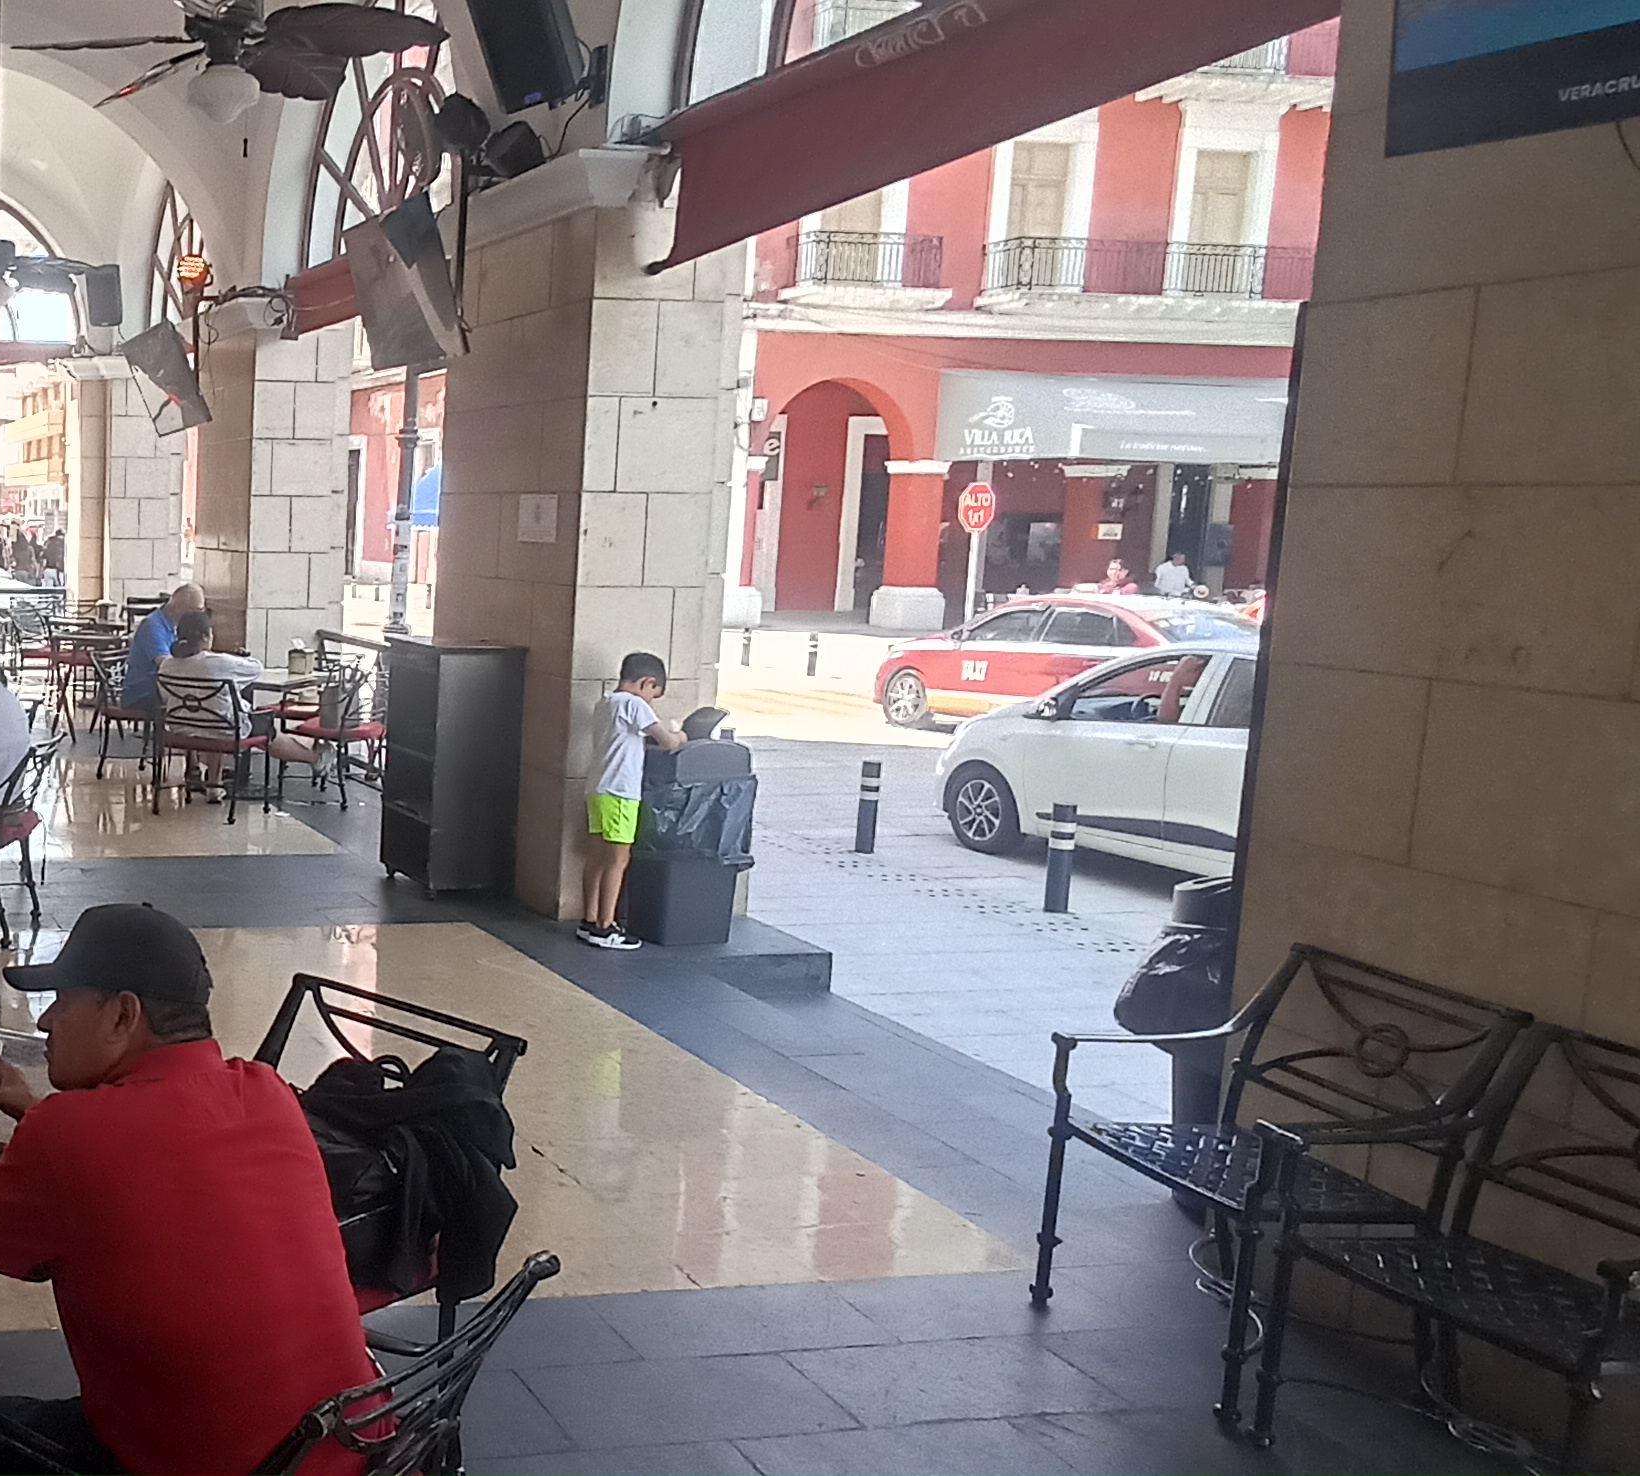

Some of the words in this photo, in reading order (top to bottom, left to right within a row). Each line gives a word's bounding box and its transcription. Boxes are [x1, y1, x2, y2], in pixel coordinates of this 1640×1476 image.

[964, 428, 999, 445] VILLA
[1003, 426, 1034, 444] RICA
[964, 493, 991, 506] ALTO
[961, 660, 988, 681] TAXI
